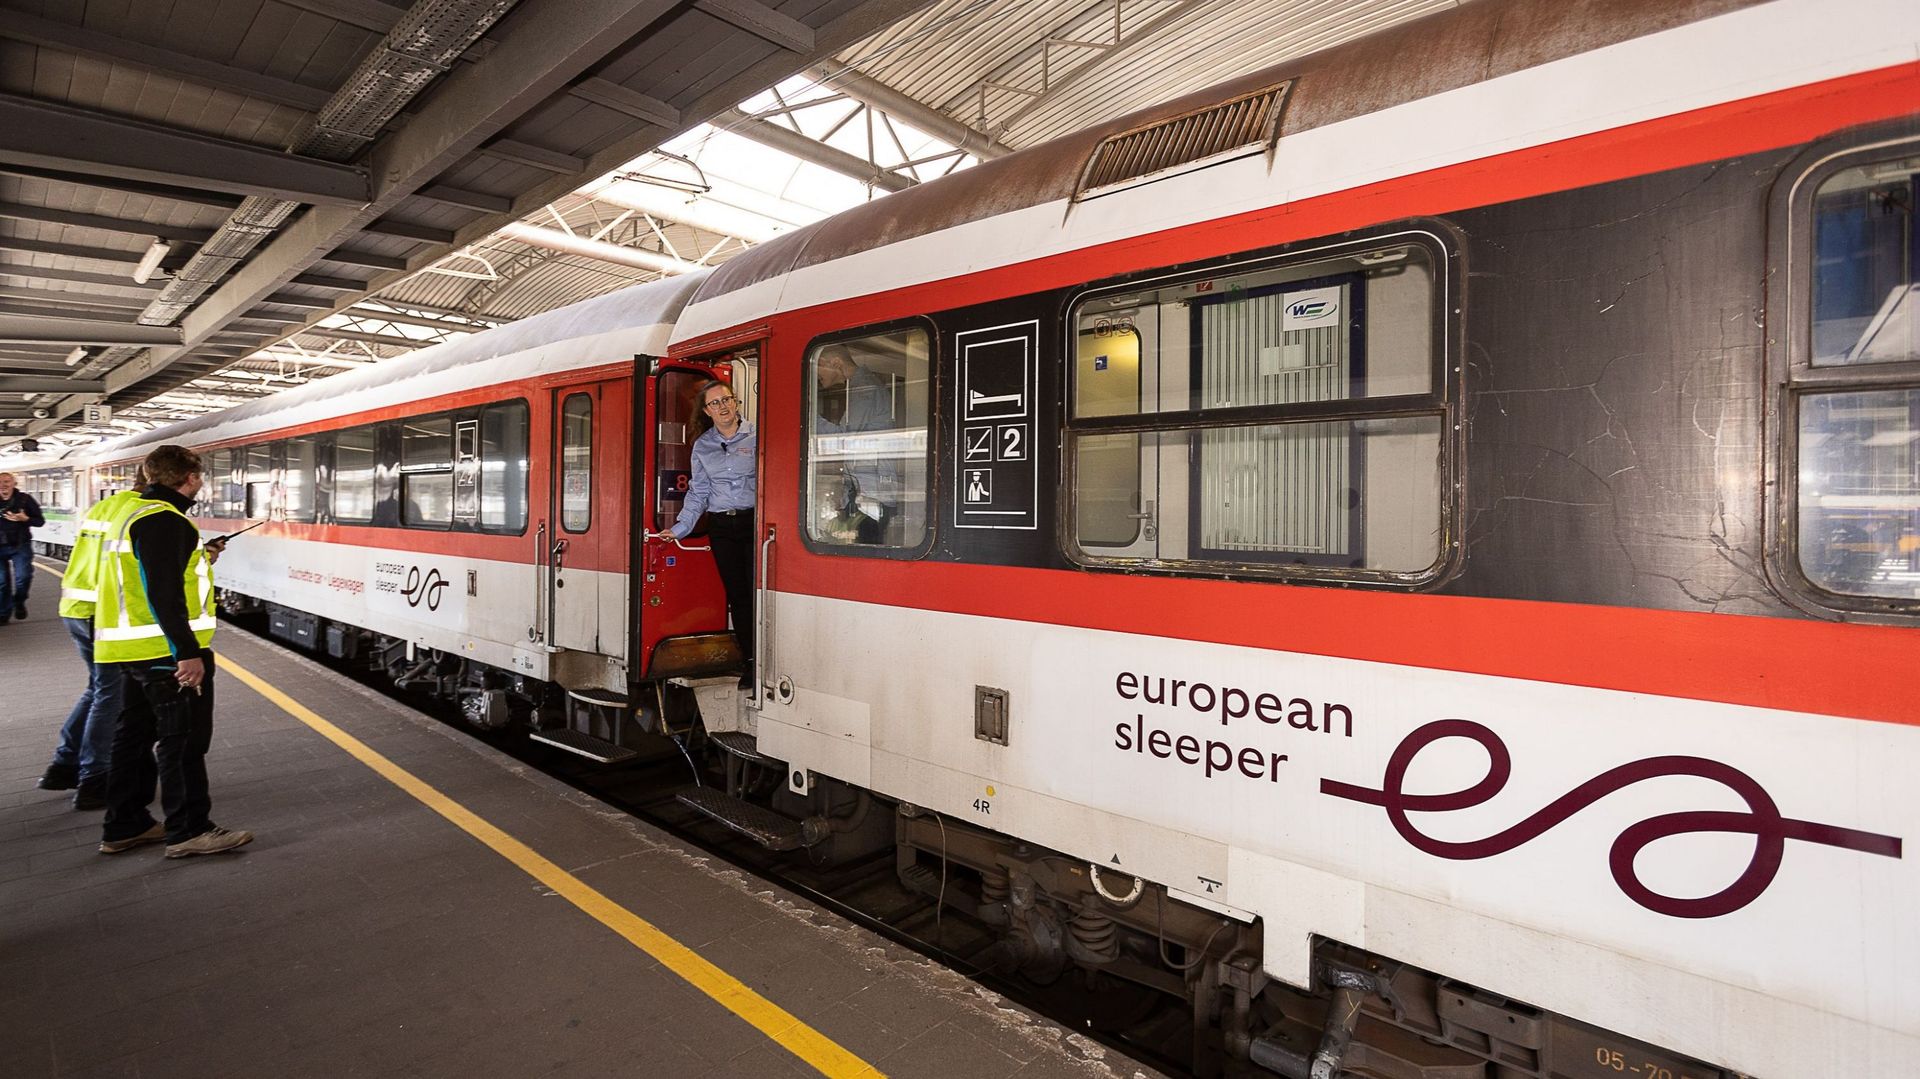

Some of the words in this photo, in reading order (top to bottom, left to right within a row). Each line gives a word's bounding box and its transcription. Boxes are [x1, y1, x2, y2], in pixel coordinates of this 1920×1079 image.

[90, 410, 100, 420] B
[1004, 428, 1020, 457] 2
[676, 474, 688, 491] 8
[376, 562, 404, 575] european
[376, 578, 398, 593] sleeper
[1116, 671, 1353, 737] european
[1115, 714, 1288, 782] sleeper
[972, 798, 990, 814] 4R
